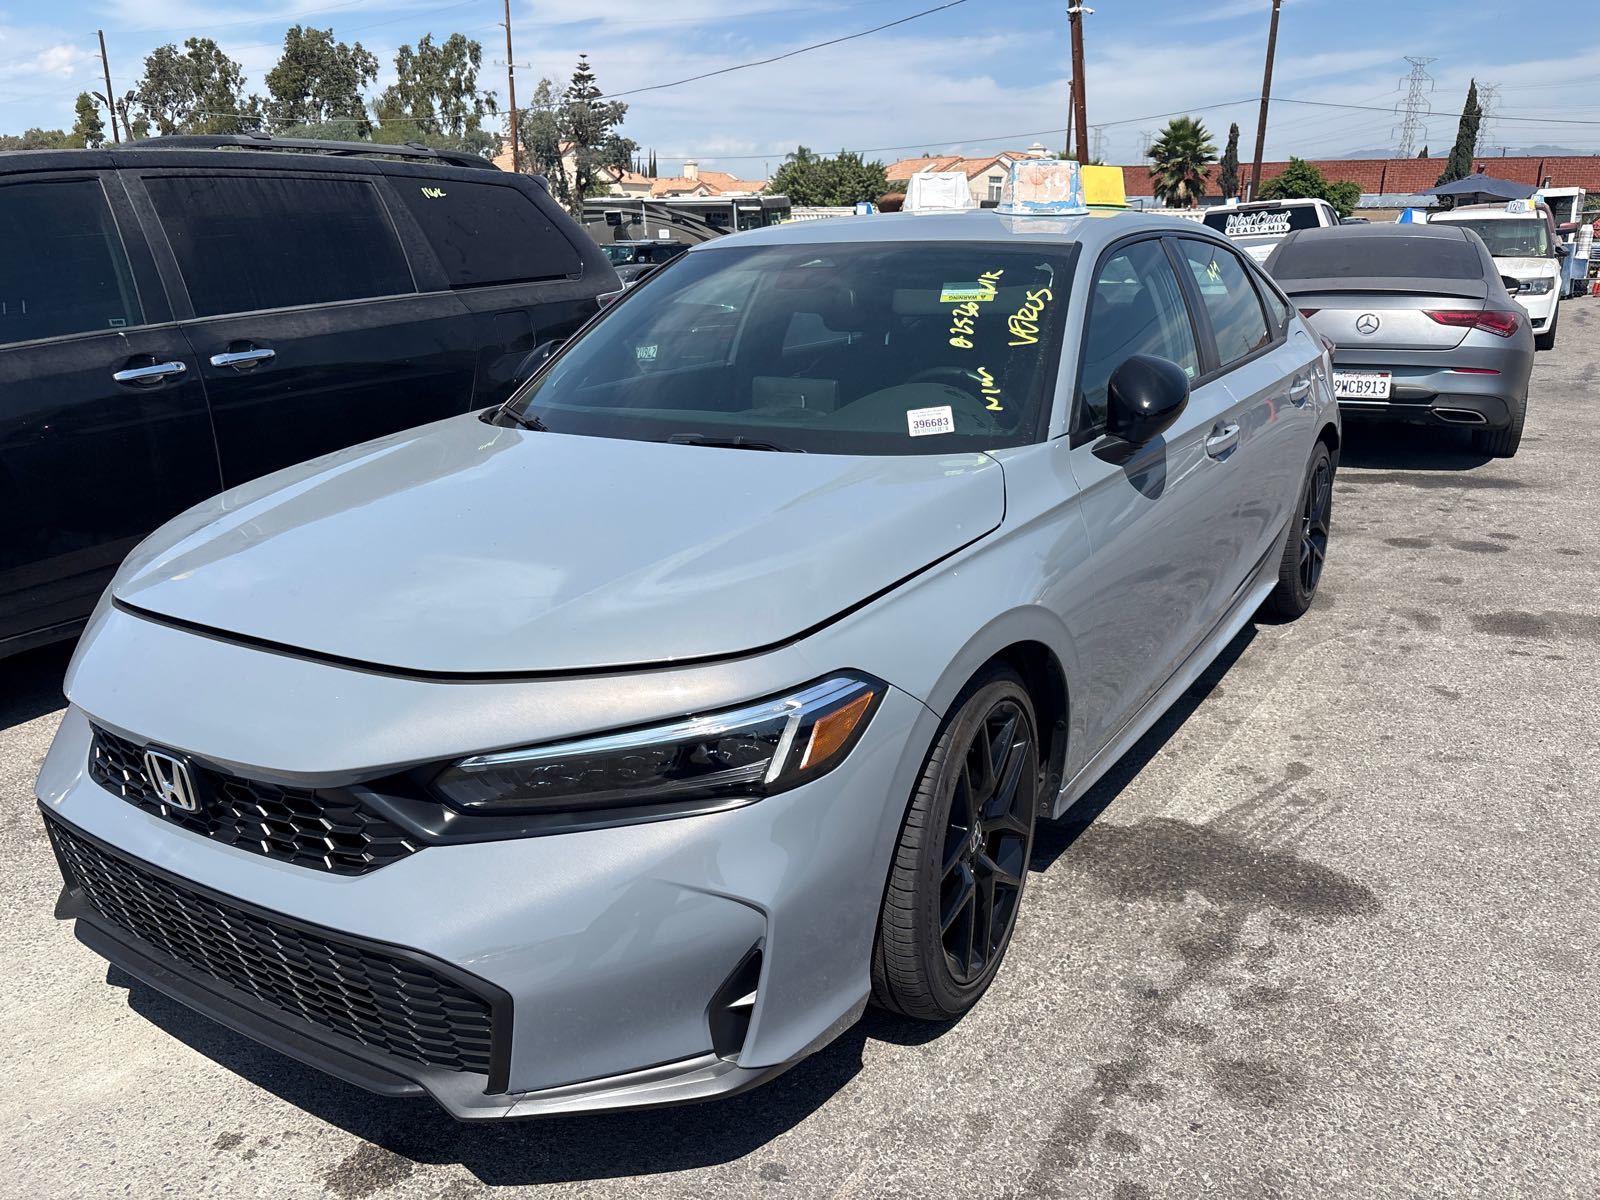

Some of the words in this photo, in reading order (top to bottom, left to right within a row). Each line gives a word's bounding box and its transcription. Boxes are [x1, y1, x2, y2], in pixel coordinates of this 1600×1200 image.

[1226, 212, 1256, 228] West
[1256, 210, 1292, 225] Coast
[1229, 224, 1287, 234] READY-MIX
[1334, 379, 1387, 394] 9WCB913
[913, 417, 949, 430] 396683
